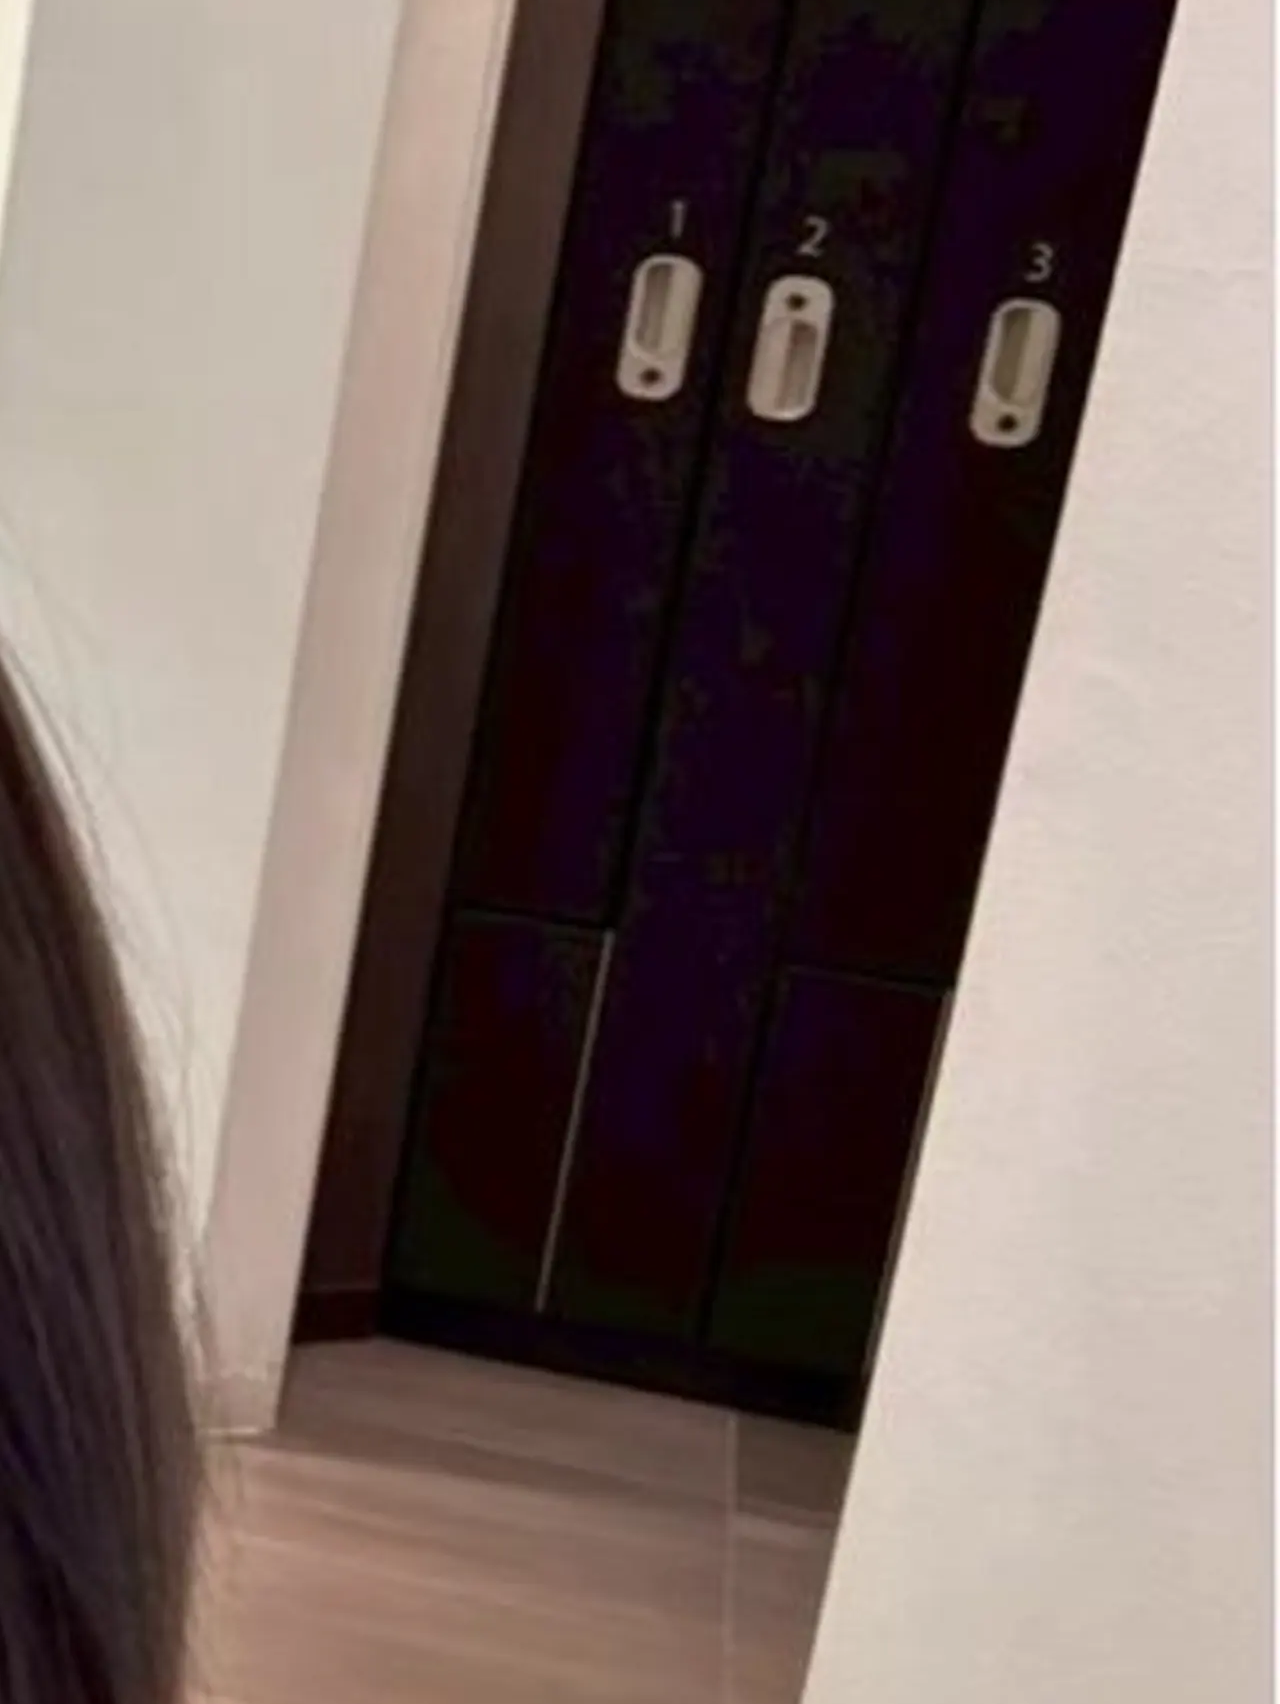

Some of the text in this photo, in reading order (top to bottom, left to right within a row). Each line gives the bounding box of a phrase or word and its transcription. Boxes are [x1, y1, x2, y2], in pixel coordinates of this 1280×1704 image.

[670, 201, 687, 239] 1
[795, 216, 830, 257] 2
[1025, 242, 1054, 282] 3
